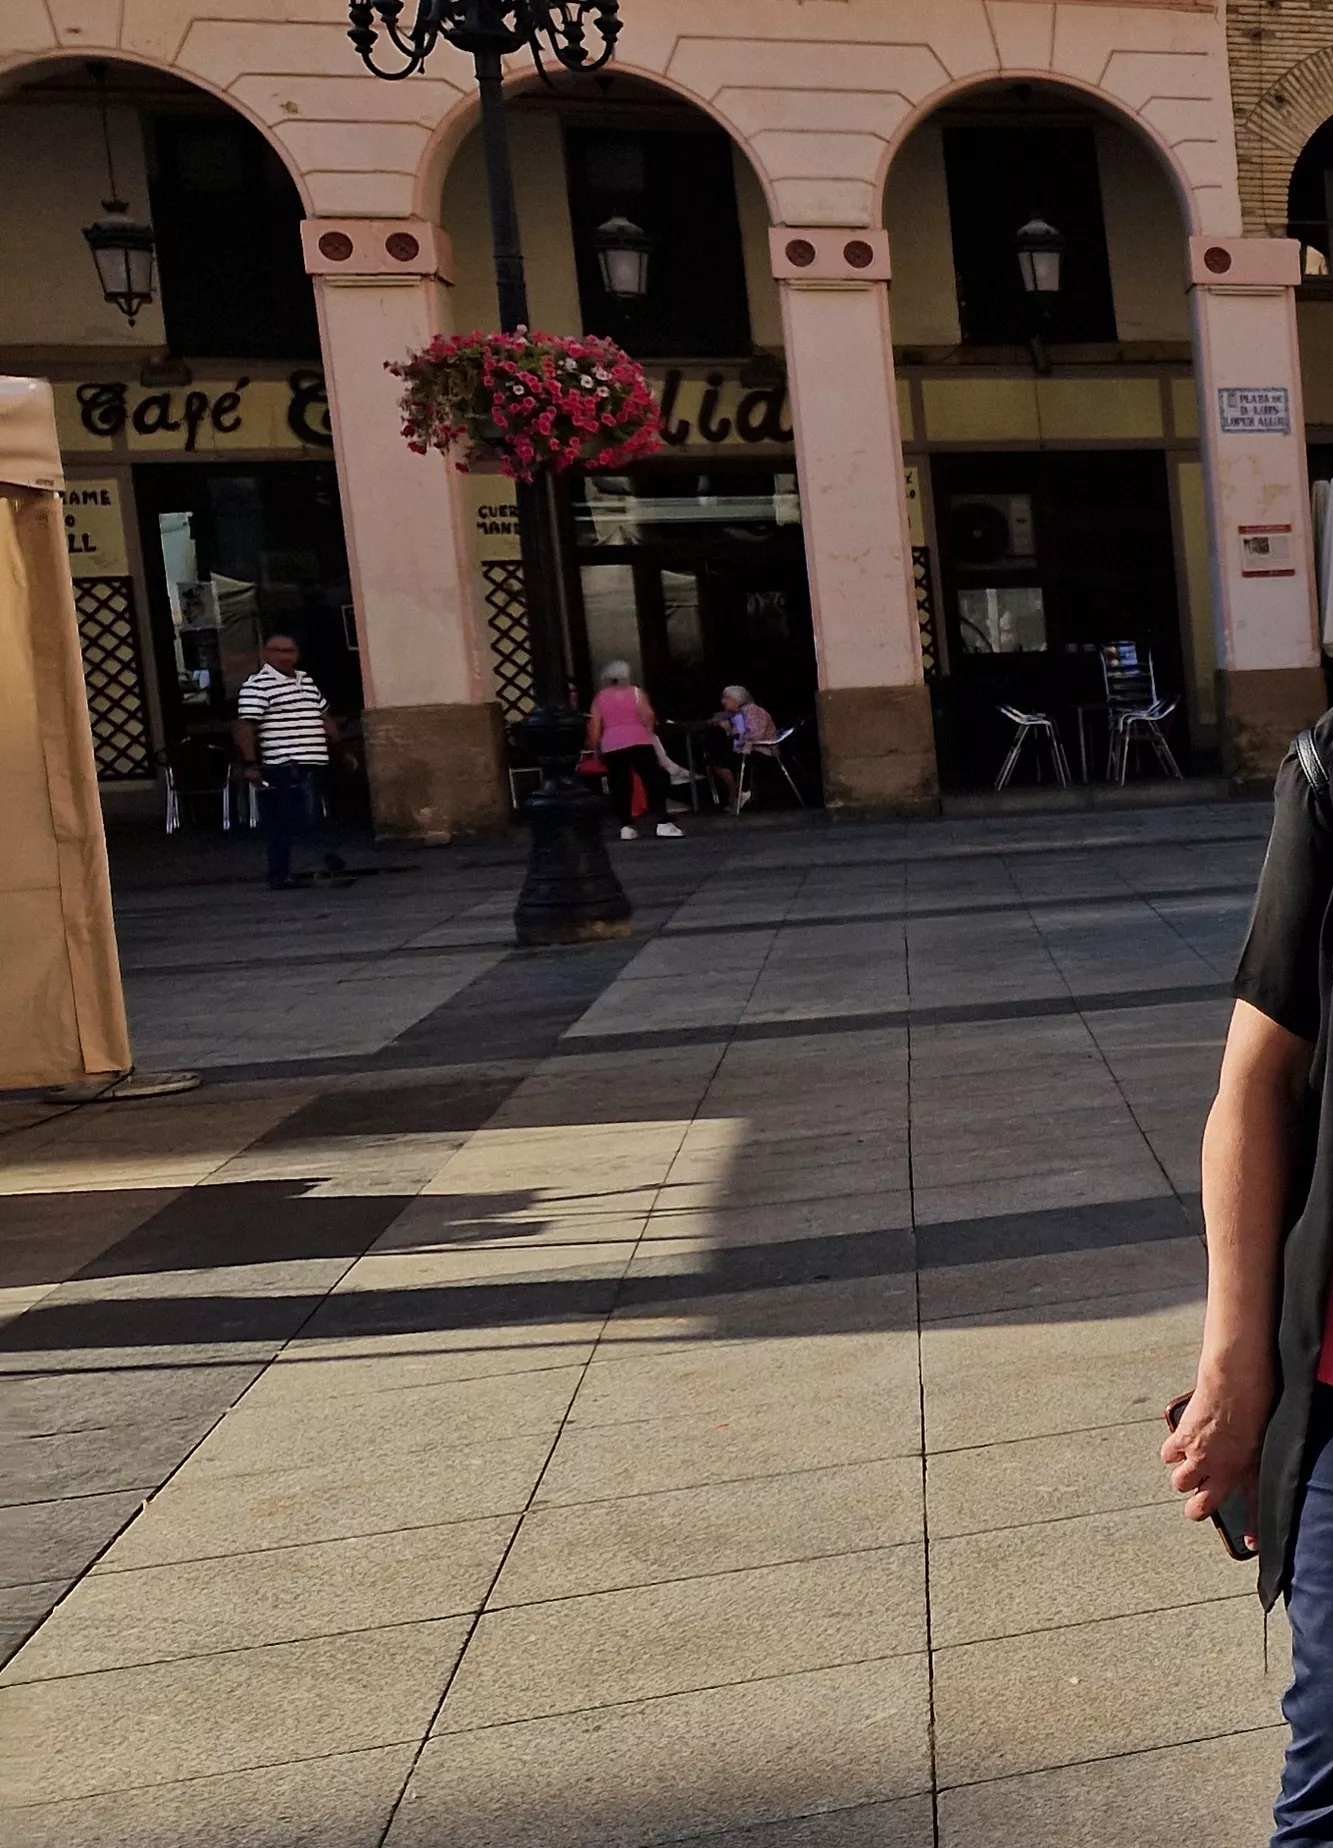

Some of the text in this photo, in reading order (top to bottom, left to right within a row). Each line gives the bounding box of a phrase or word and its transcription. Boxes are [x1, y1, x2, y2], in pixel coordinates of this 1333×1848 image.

[77, 376, 249, 451] Café
[477, 504, 520, 519] CUER
[65, 514, 75, 527] O
[68, 533, 97, 553] LL
